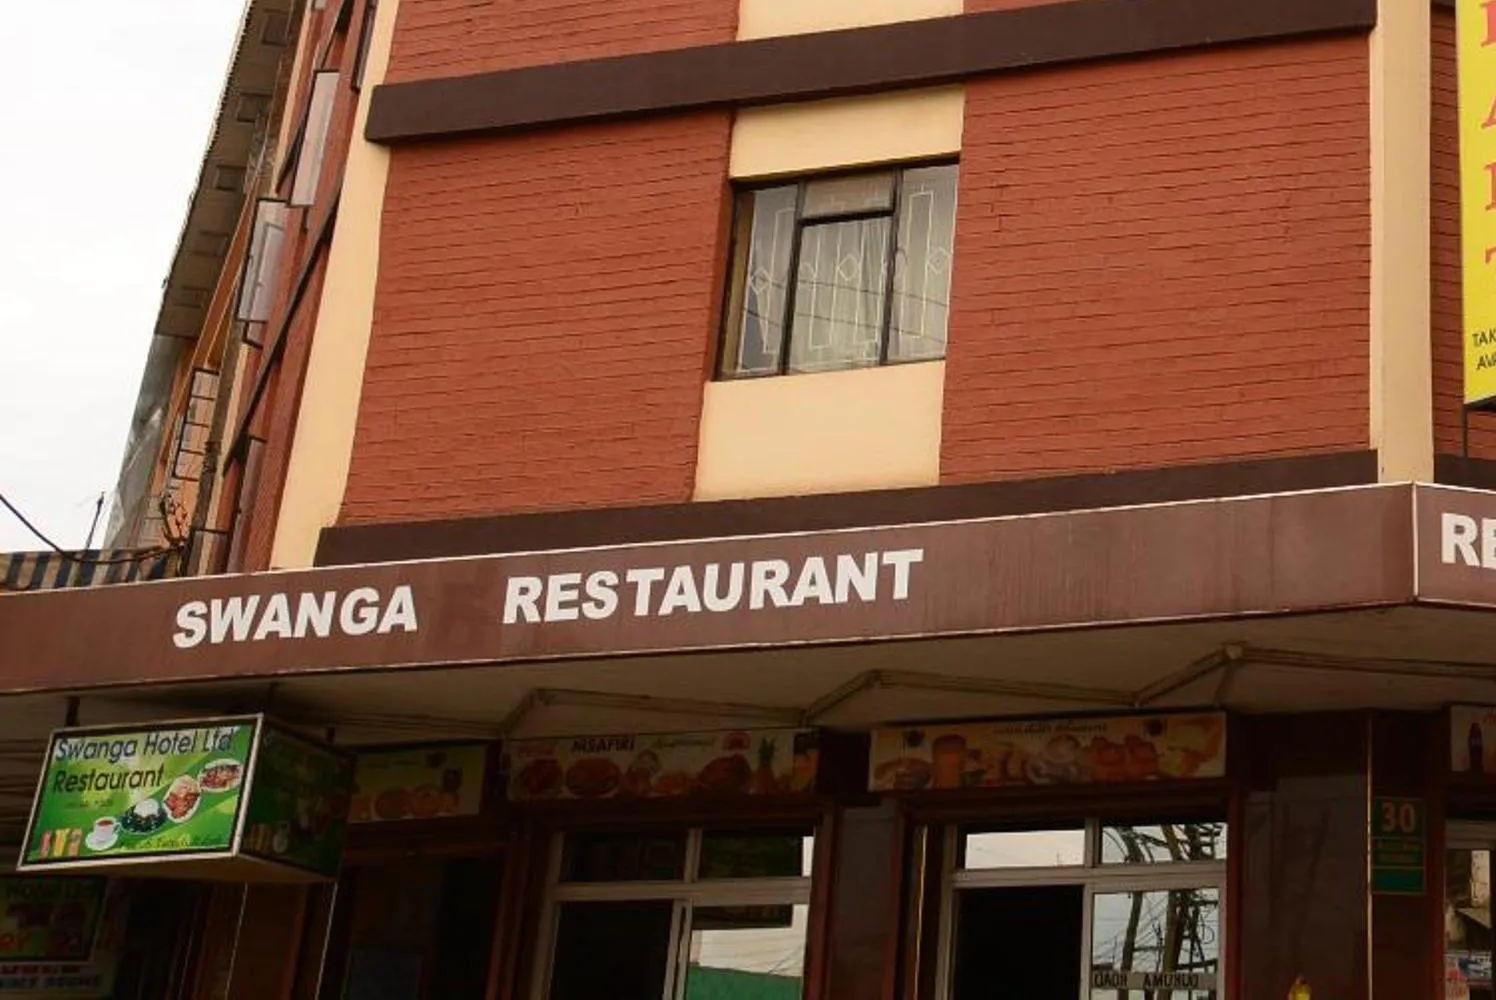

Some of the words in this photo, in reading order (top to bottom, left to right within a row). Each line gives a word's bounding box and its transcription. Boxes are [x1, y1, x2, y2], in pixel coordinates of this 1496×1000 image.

[172, 585, 418, 649] SWANGA
[502, 549, 924, 624] RESTAURANT
[55, 736, 138, 764] Swanga
[143, 730, 197, 756] Hotel
[202, 727, 236, 752] Ltd
[53, 763, 164, 792] Restaurant
[1379, 801, 1417, 833] 30
